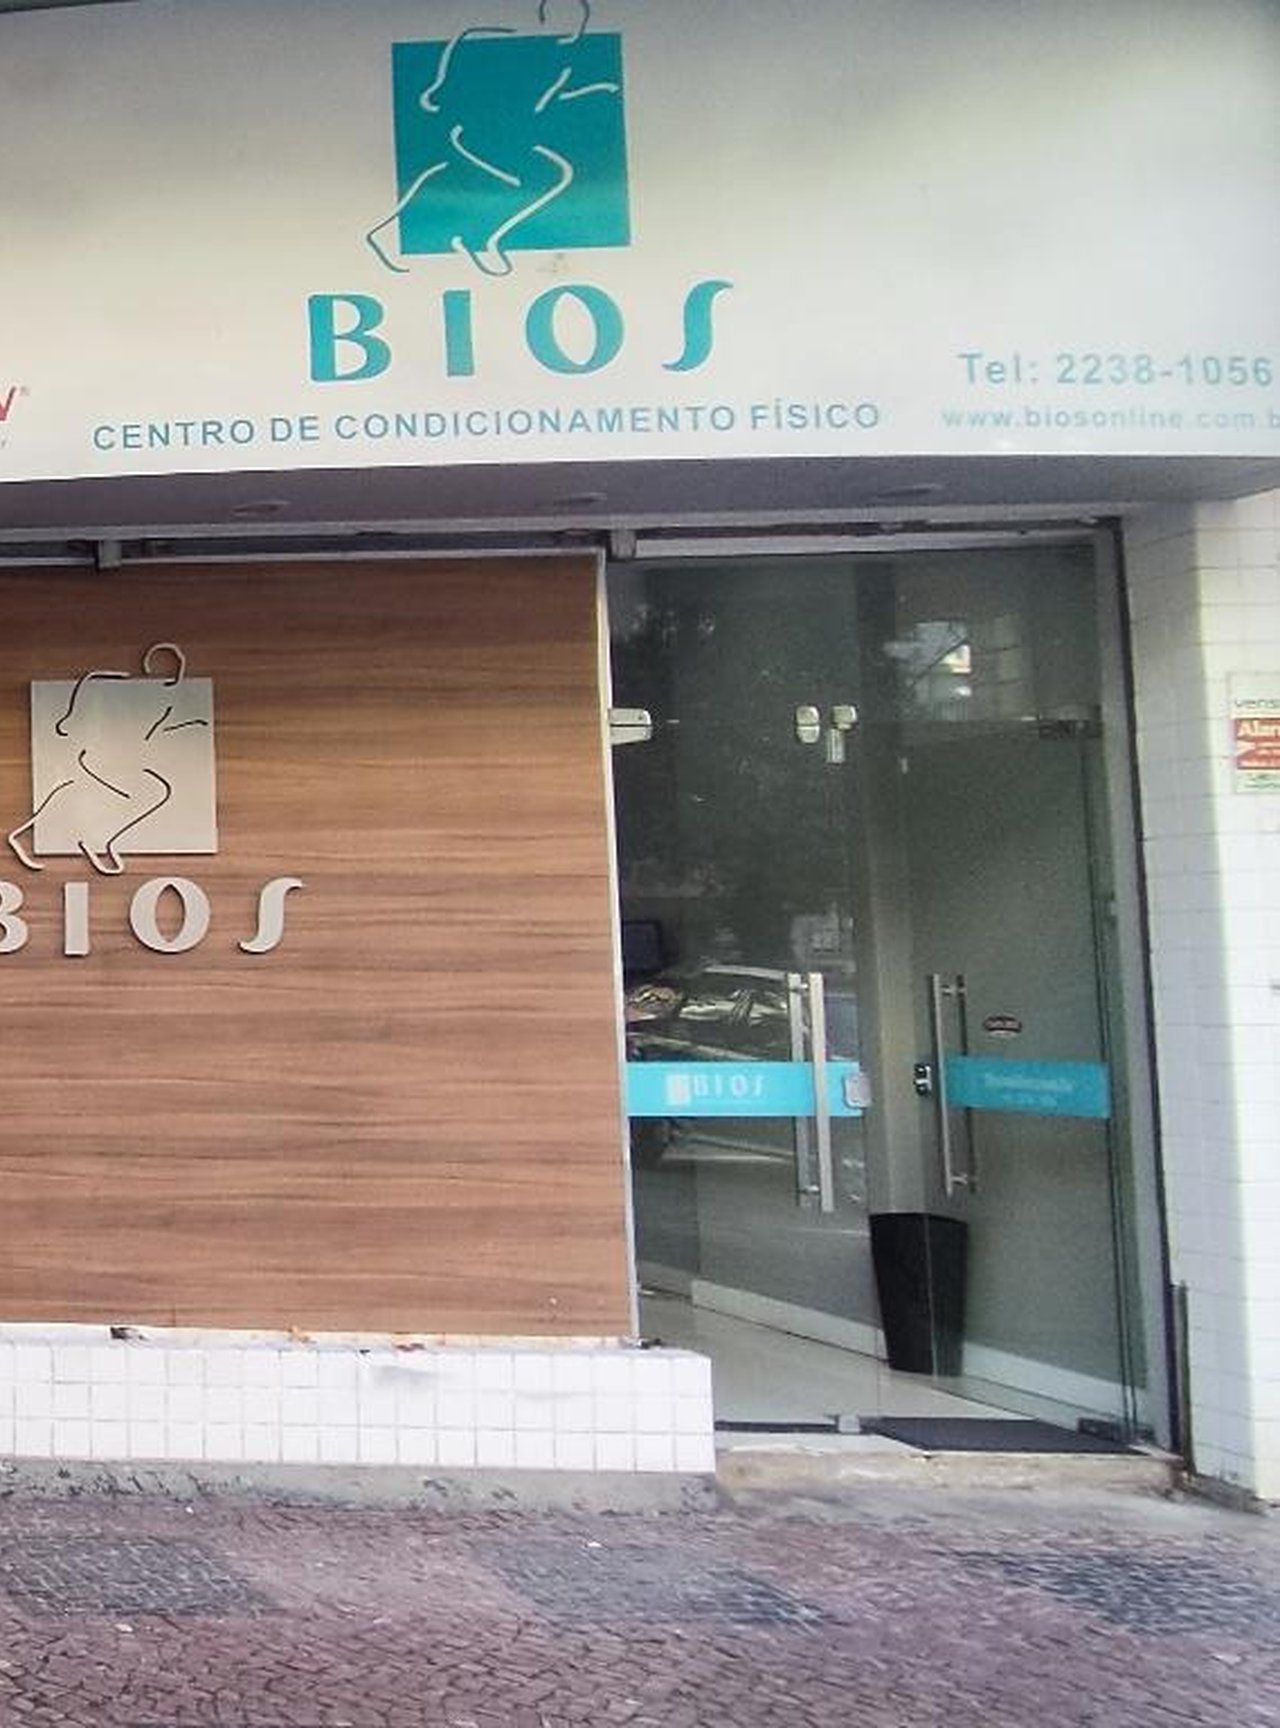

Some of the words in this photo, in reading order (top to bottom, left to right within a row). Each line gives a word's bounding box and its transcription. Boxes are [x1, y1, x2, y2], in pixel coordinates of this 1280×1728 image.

[307, 280, 734, 382] BIOS
[957, 351, 1039, 385] Tel:
[1056, 352, 1273, 387] 2238-1056
[92, 419, 255, 451] CENTRO
[270, 415, 321, 442] DE
[334, 403, 736, 440] CONDICIONAMENTO
[750, 397, 880, 431] FÍSICO
